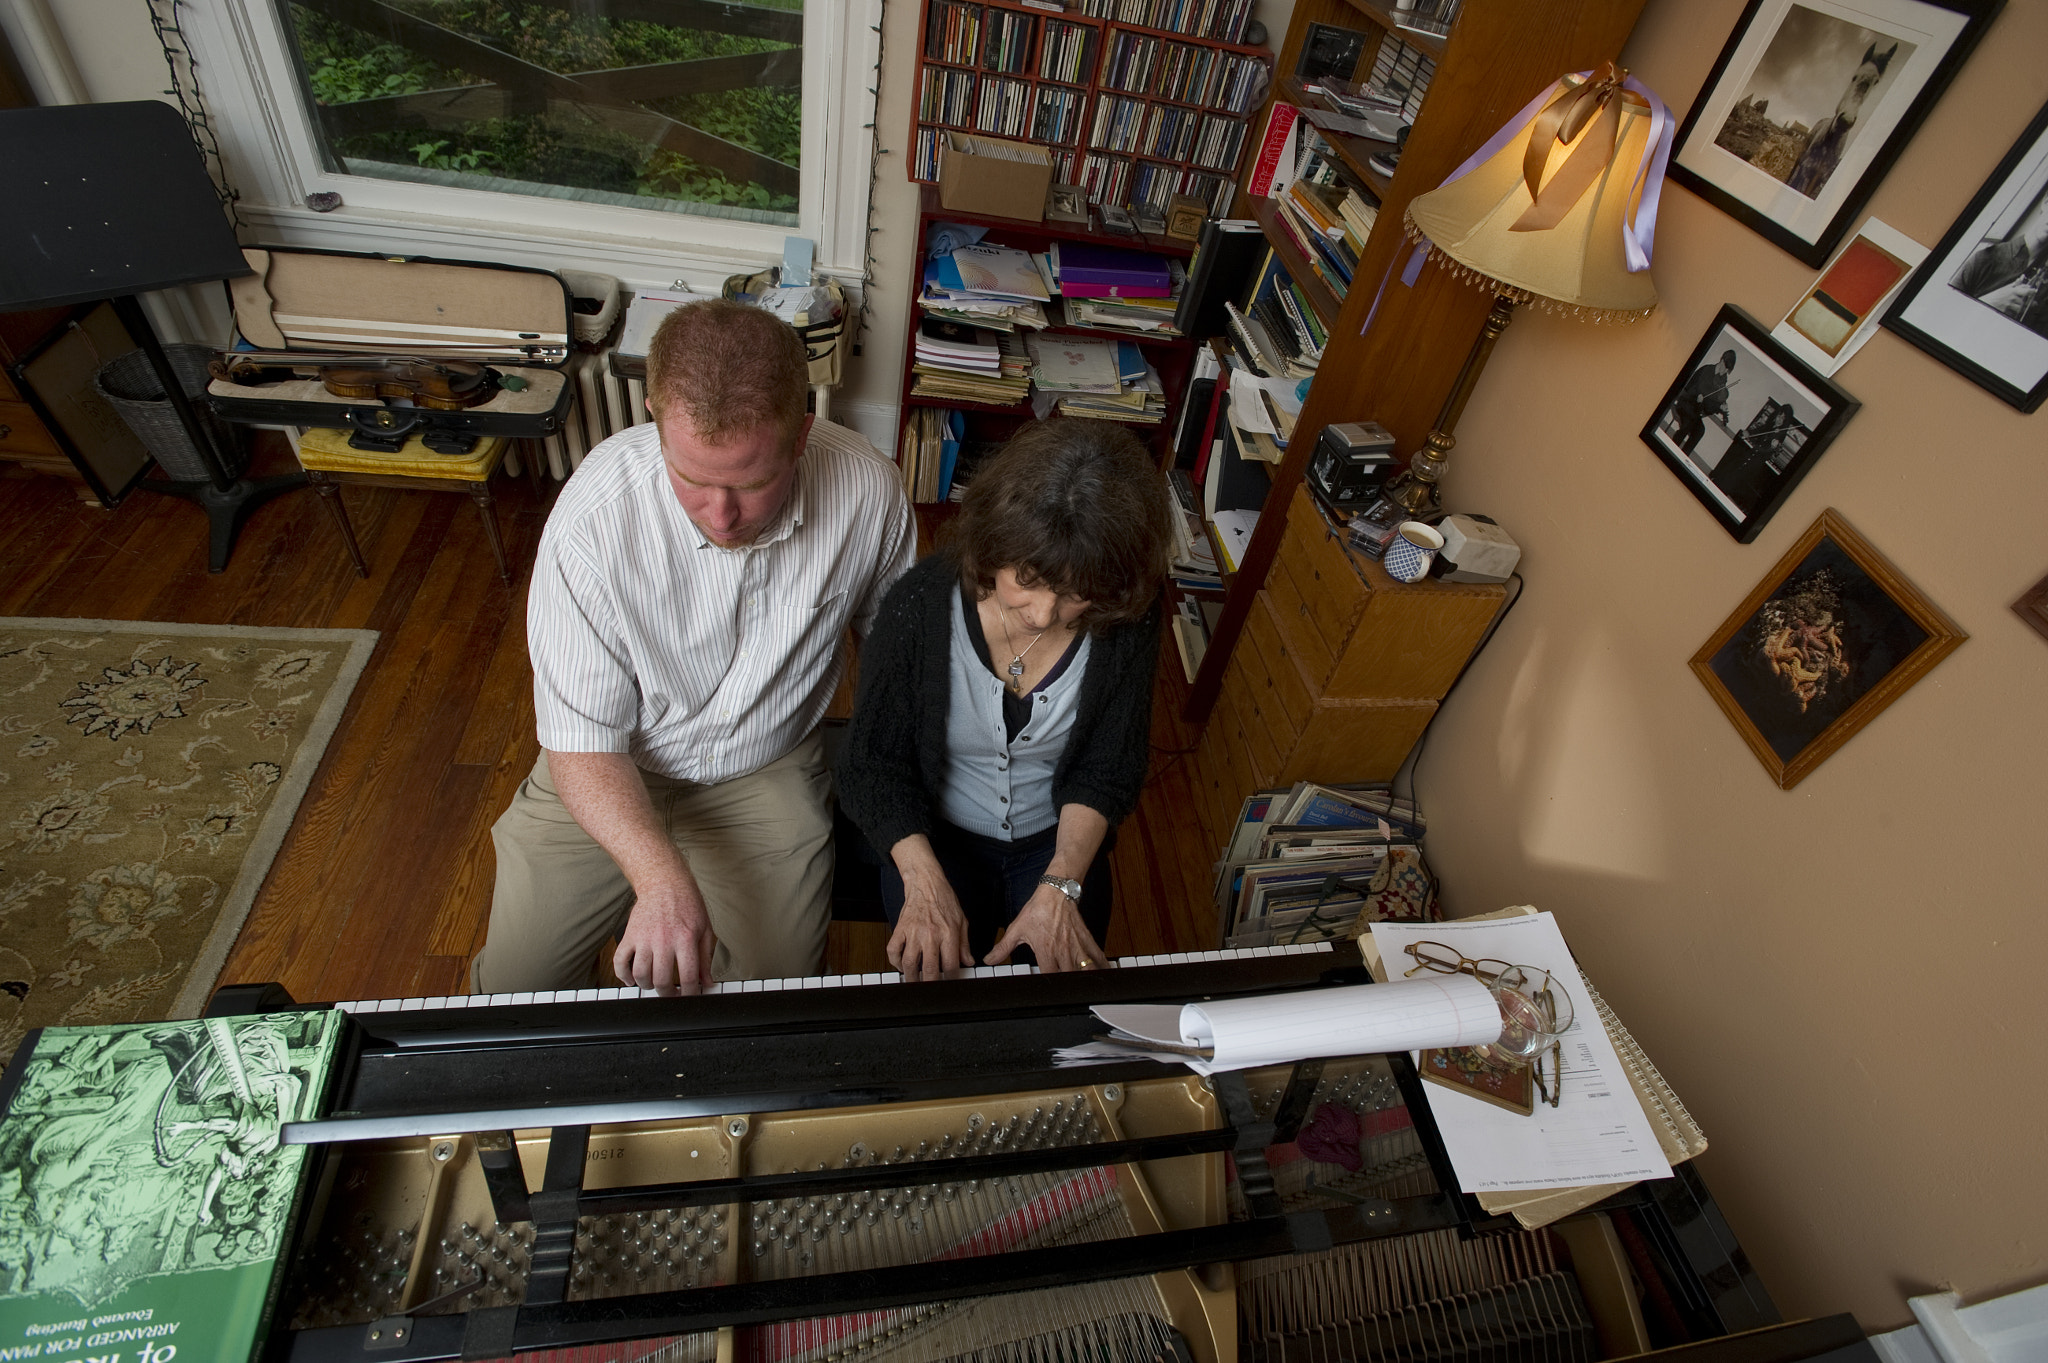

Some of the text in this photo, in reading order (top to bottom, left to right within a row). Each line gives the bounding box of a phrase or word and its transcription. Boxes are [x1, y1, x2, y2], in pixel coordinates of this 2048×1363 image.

[1317, 798, 1347, 816] Carolan's
[25, 1309, 154, 1337] Edward Bunting
[86, 1322, 180, 1347] ARRANGED
[45, 1337, 82, 1354] FOR
